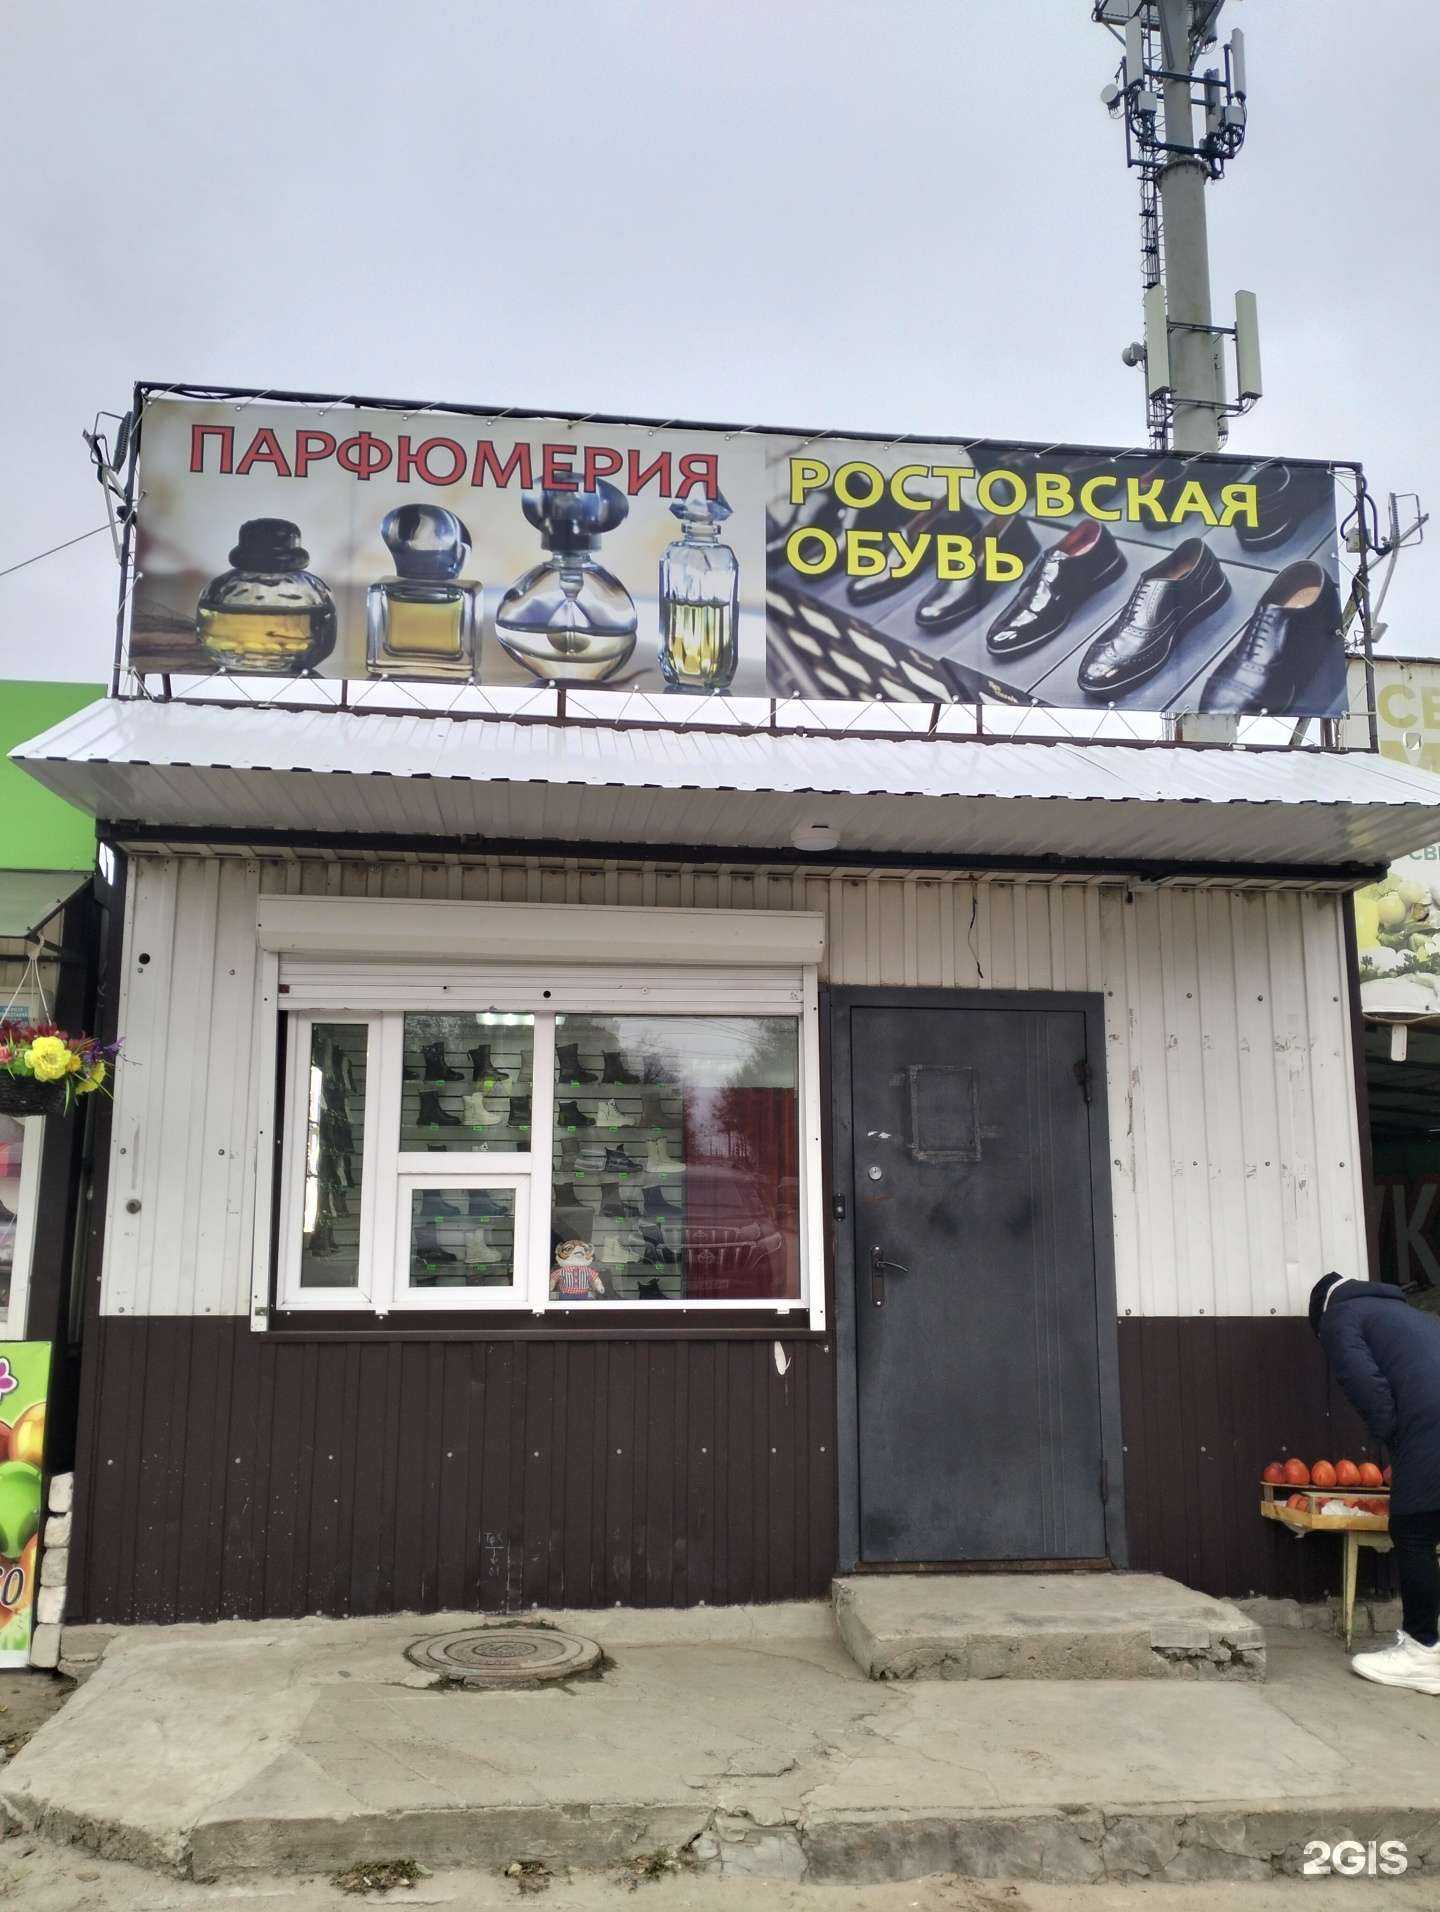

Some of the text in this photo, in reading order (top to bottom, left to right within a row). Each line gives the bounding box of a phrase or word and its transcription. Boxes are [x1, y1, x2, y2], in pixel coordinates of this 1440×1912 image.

[190, 424, 719, 500] ПАРФЮМЕРИЯ
[789, 457, 1259, 527] РОСТОВСКАЯ
[786, 527, 1024, 582] ОБУВЬ
